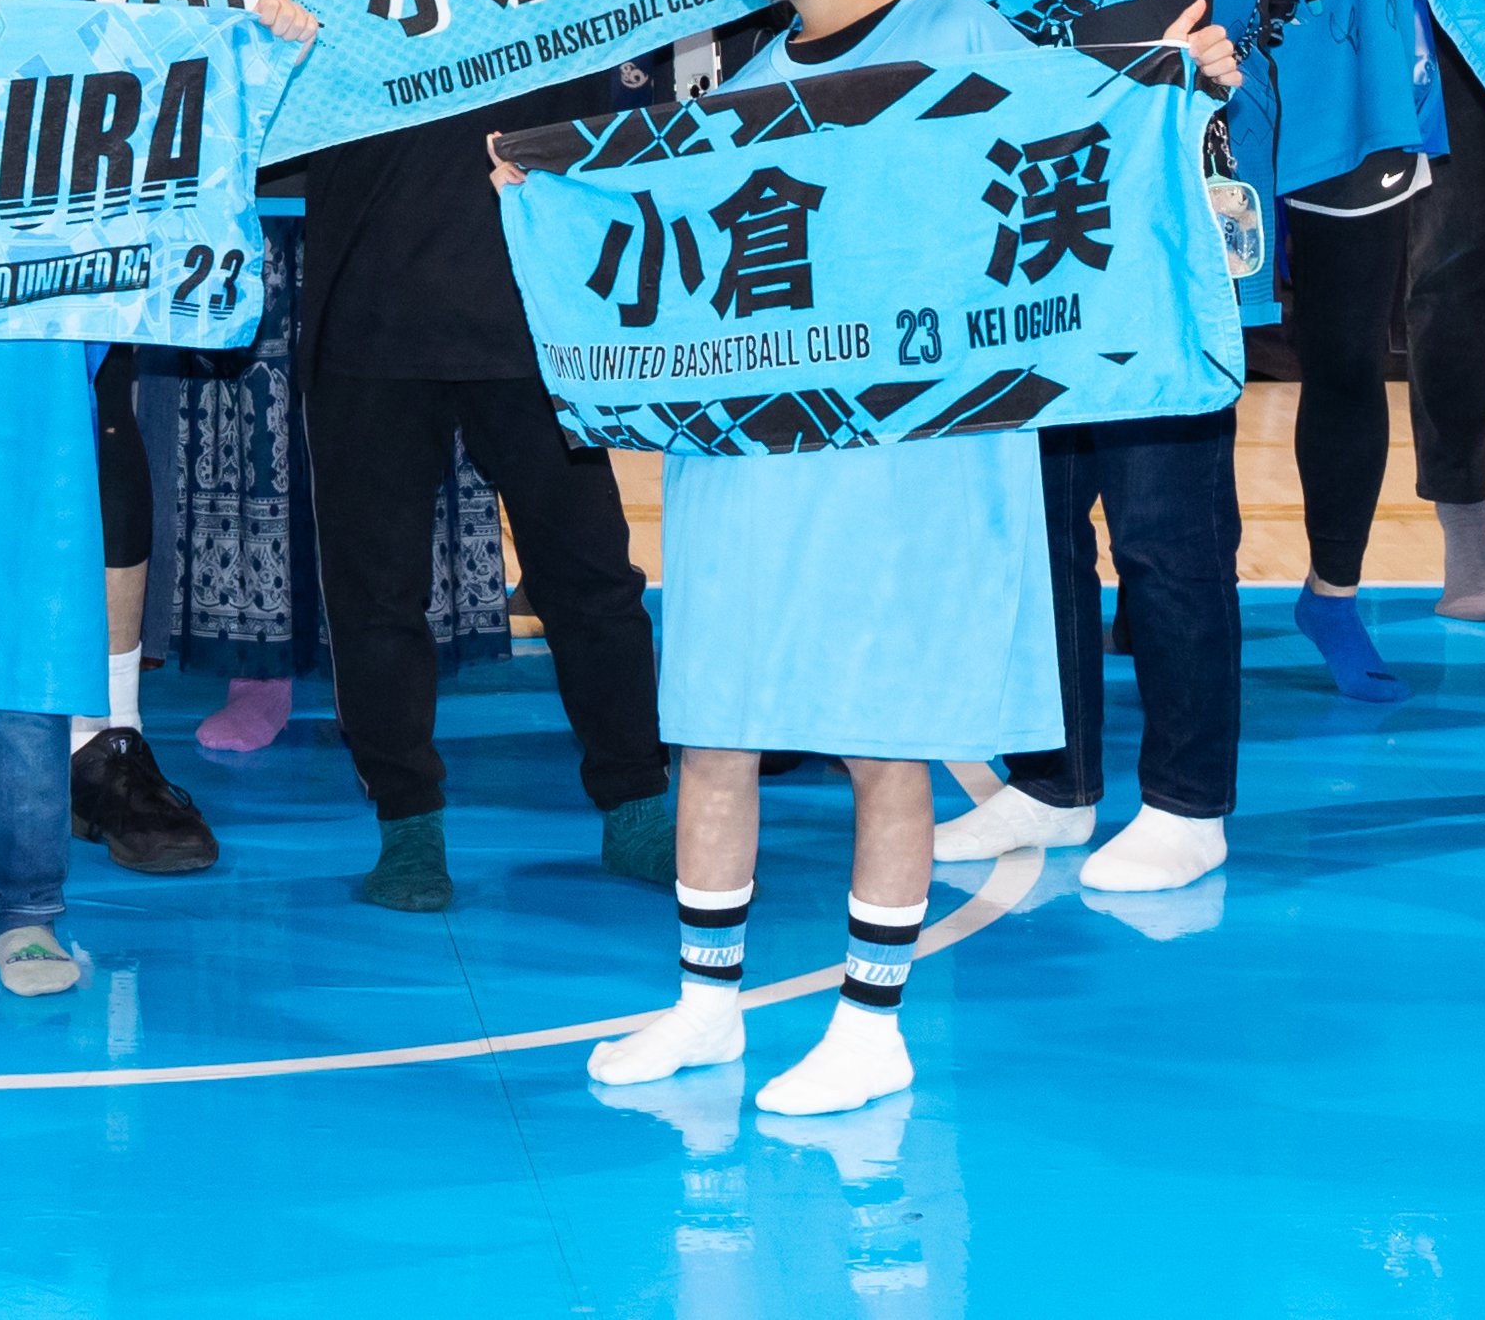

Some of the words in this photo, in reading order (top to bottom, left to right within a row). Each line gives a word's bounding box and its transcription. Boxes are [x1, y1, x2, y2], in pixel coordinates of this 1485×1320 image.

[383, 63, 457, 108] TOKYO
[457, 40, 532, 93] UNITED
[585, 165, 828, 329] 小倉
[980, 121, 1115, 288] 渓
[13, 254, 111, 305] UNITED
[115, 244, 151, 288] BC
[169, 243, 246, 320] 23
[542, 343, 586, 384] TOKYO
[588, 341, 669, 383] UNITED
[670, 330, 802, 379] BASKETBALL
[806, 322, 871, 363] CLUB
[895, 307, 942, 367] 23
[965, 307, 1008, 349] KEI
[1013, 292, 1083, 344] OGURA
